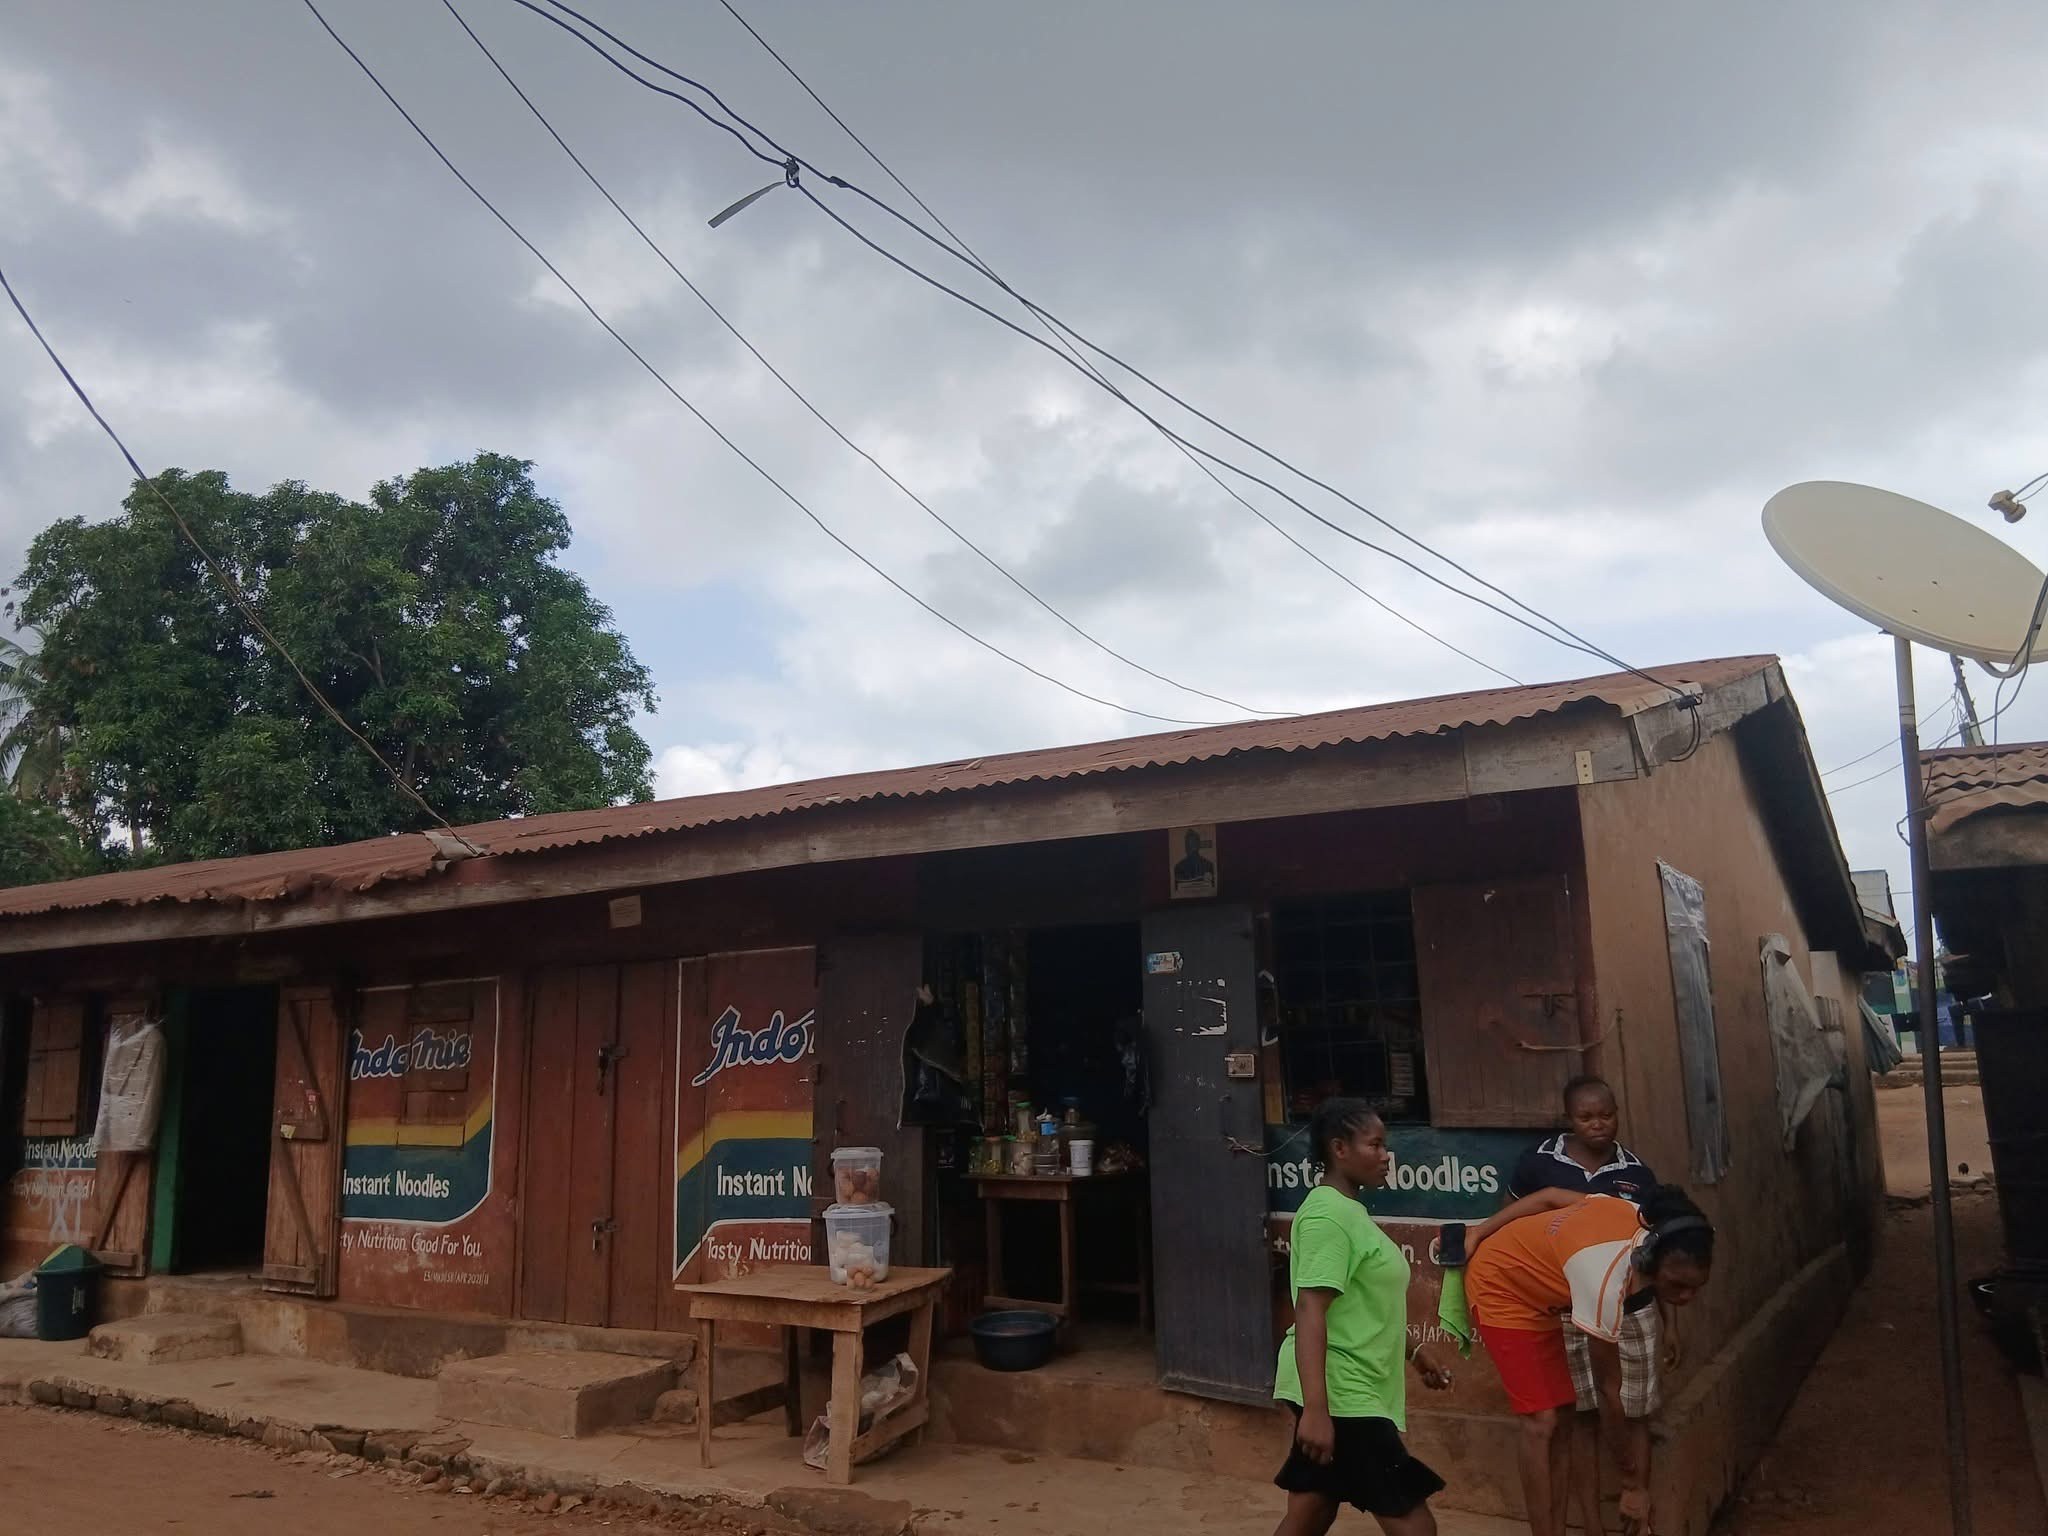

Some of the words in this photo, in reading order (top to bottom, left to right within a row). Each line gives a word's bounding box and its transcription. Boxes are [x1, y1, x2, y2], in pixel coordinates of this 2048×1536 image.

[692, 1004, 815, 1087] Indo
[59, 1137, 96, 1161] Noodle
[343, 1168, 390, 1196] Instant
[396, 1169, 450, 1198] Noodles
[717, 1164, 785, 1197] Instant
[357, 1229, 407, 1251] Nutrition.
[411, 1232, 439, 1254] Good
[440, 1234, 459, 1255] For
[462, 1234, 483, 1257] You.
[707, 1236, 742, 1266] Tasty
